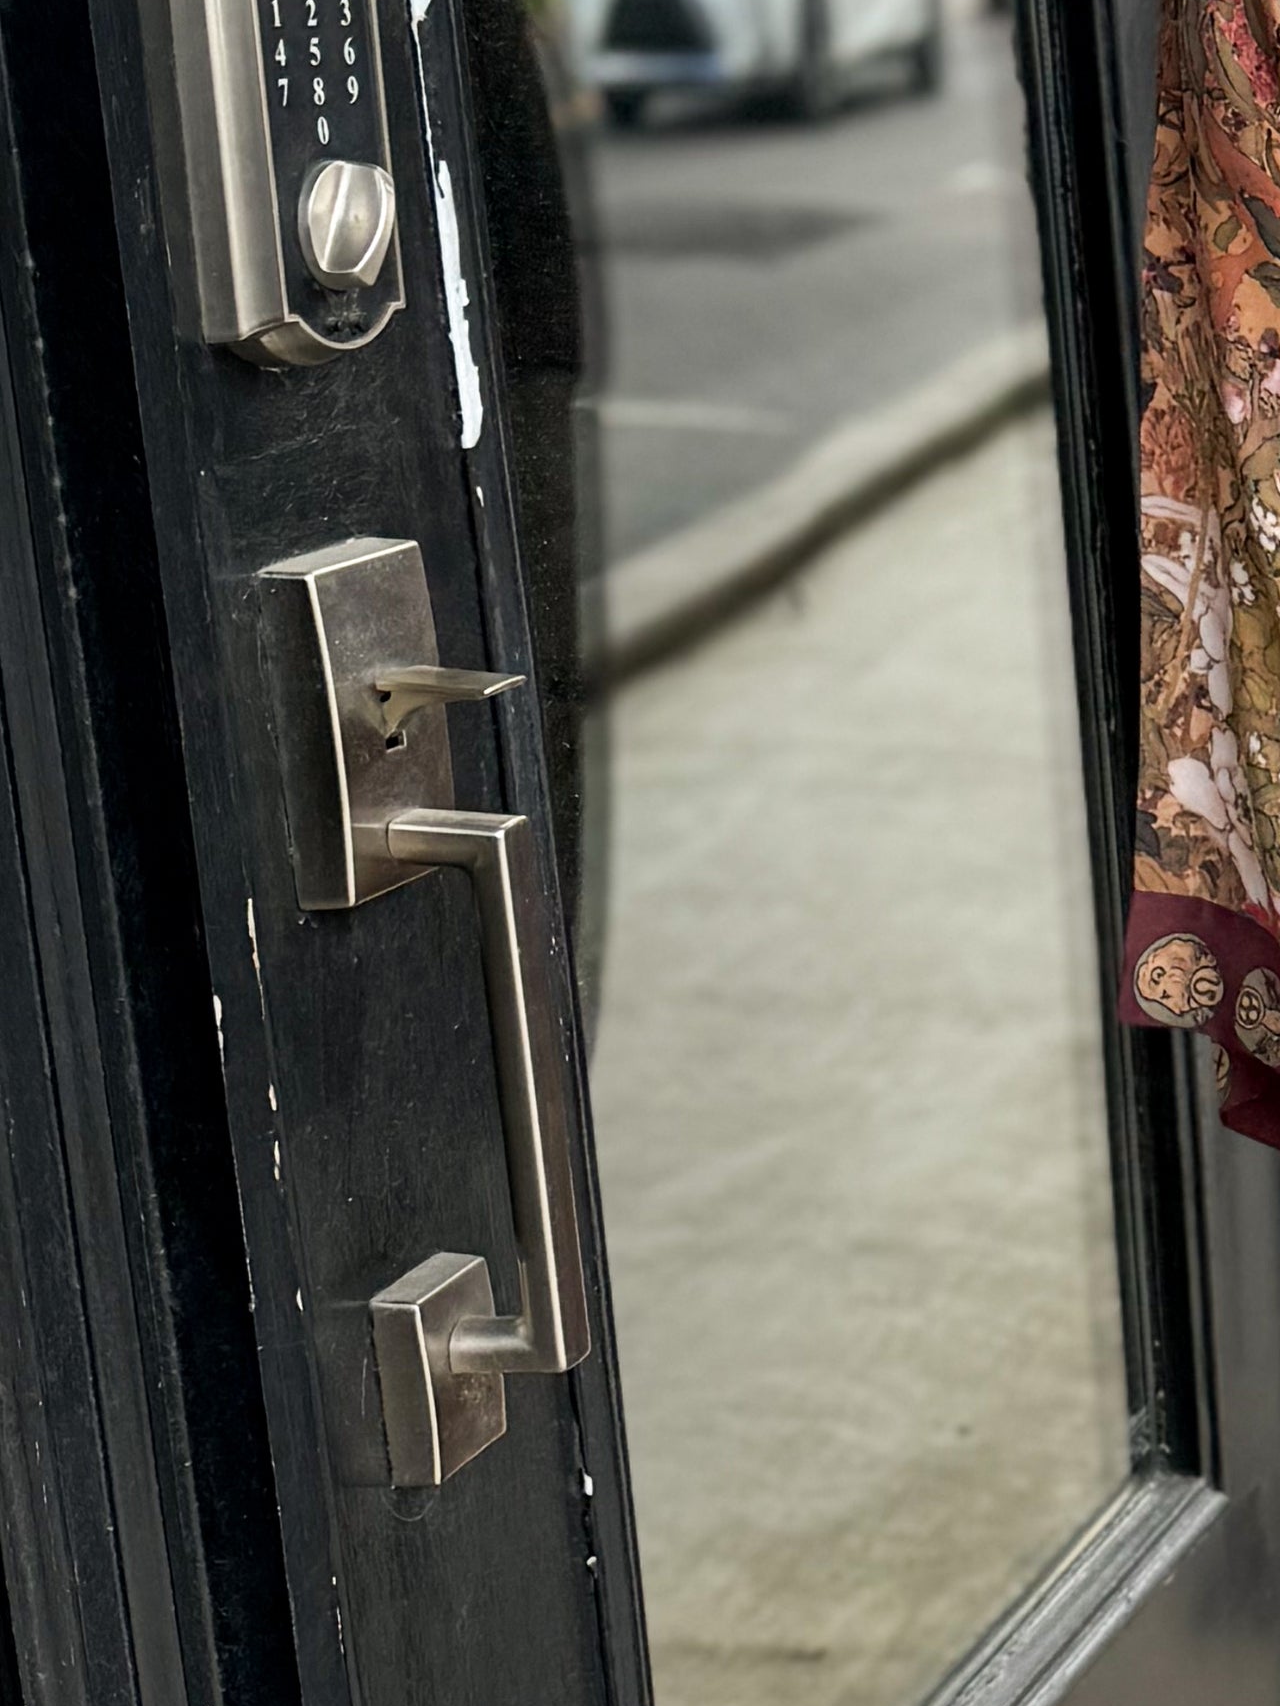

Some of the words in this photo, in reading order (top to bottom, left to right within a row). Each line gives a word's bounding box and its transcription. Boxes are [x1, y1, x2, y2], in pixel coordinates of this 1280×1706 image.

[274, 38, 287, 67] 4
[309, 37, 321, 66] 5
[343, 36, 356, 65] 6
[277, 78, 289, 107] 7
[312, 77, 325, 106] 8
[346, 75, 359, 104] 9
[317, 116, 330, 145] 0
